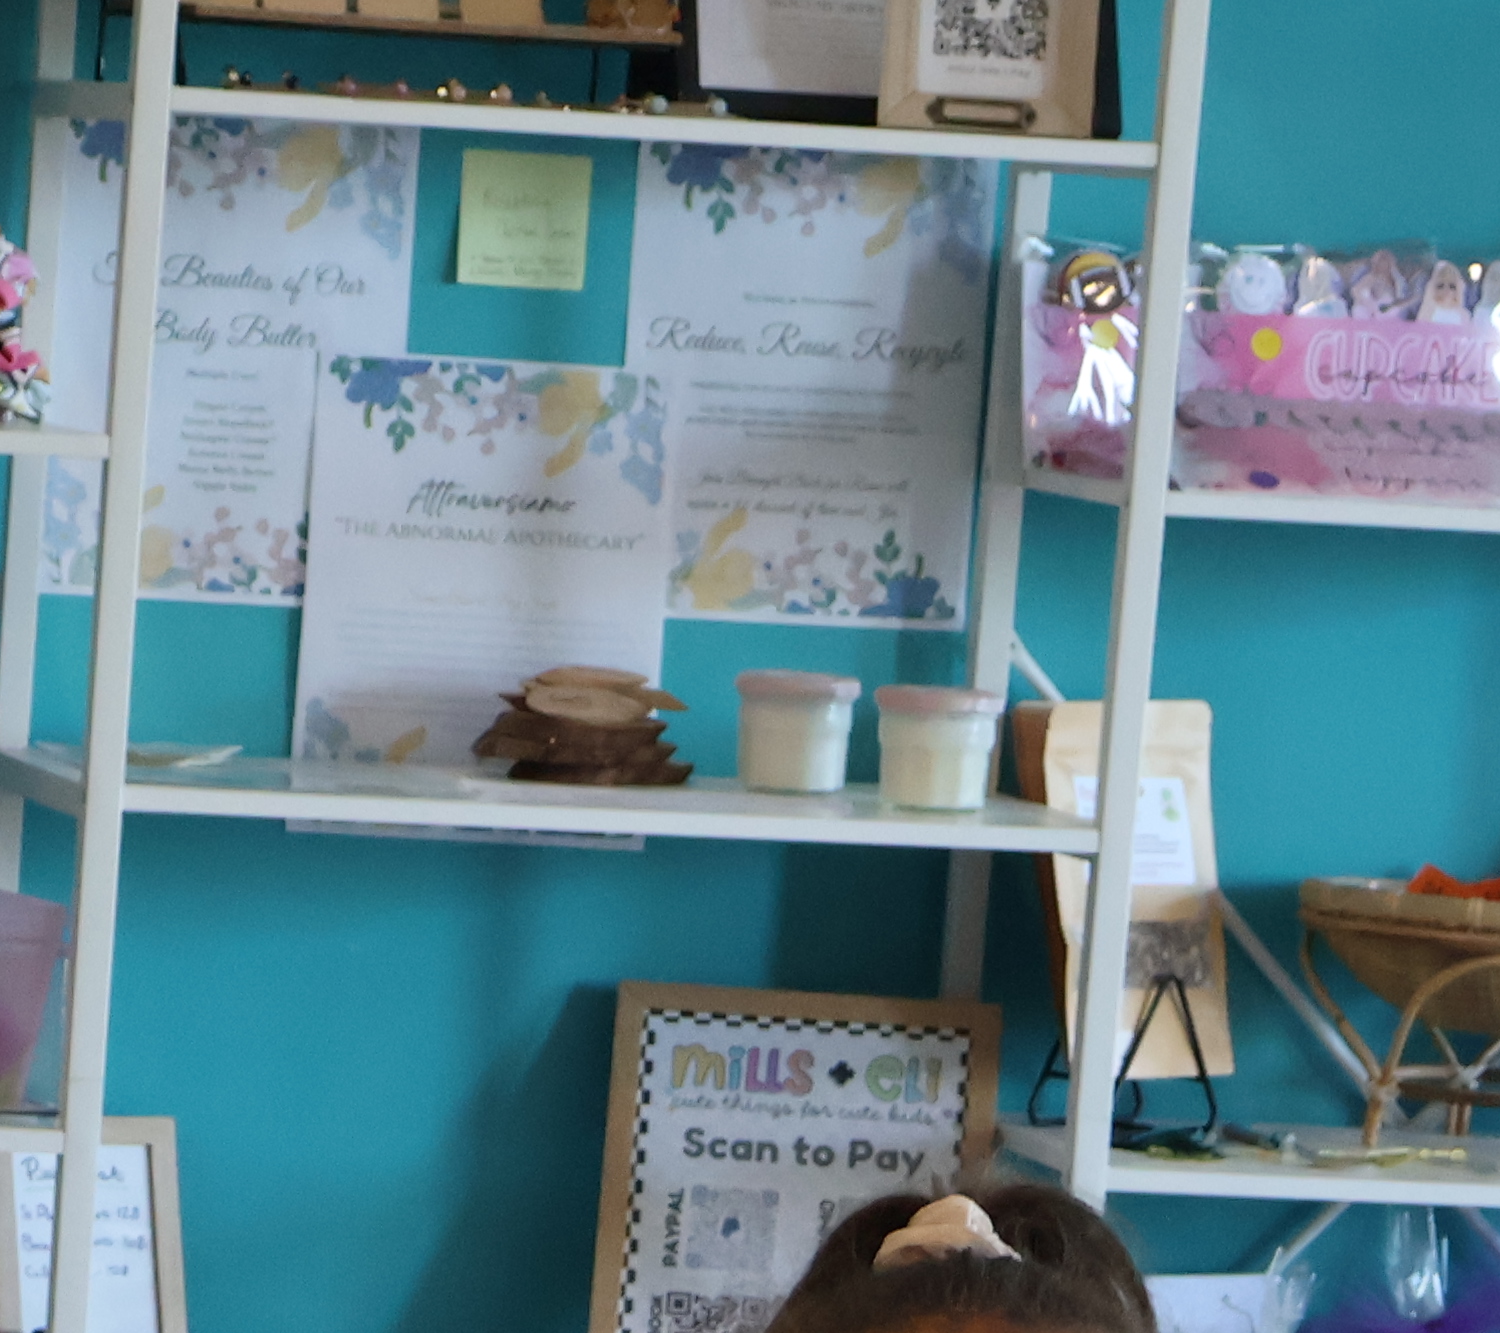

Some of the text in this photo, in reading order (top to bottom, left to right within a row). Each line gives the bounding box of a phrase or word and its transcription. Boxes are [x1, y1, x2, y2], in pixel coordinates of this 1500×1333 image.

[281, 265, 310, 305] of
[683, 1127, 925, 1178] Scan to Pay
[662, 1186, 684, 1269] PAYPAL
